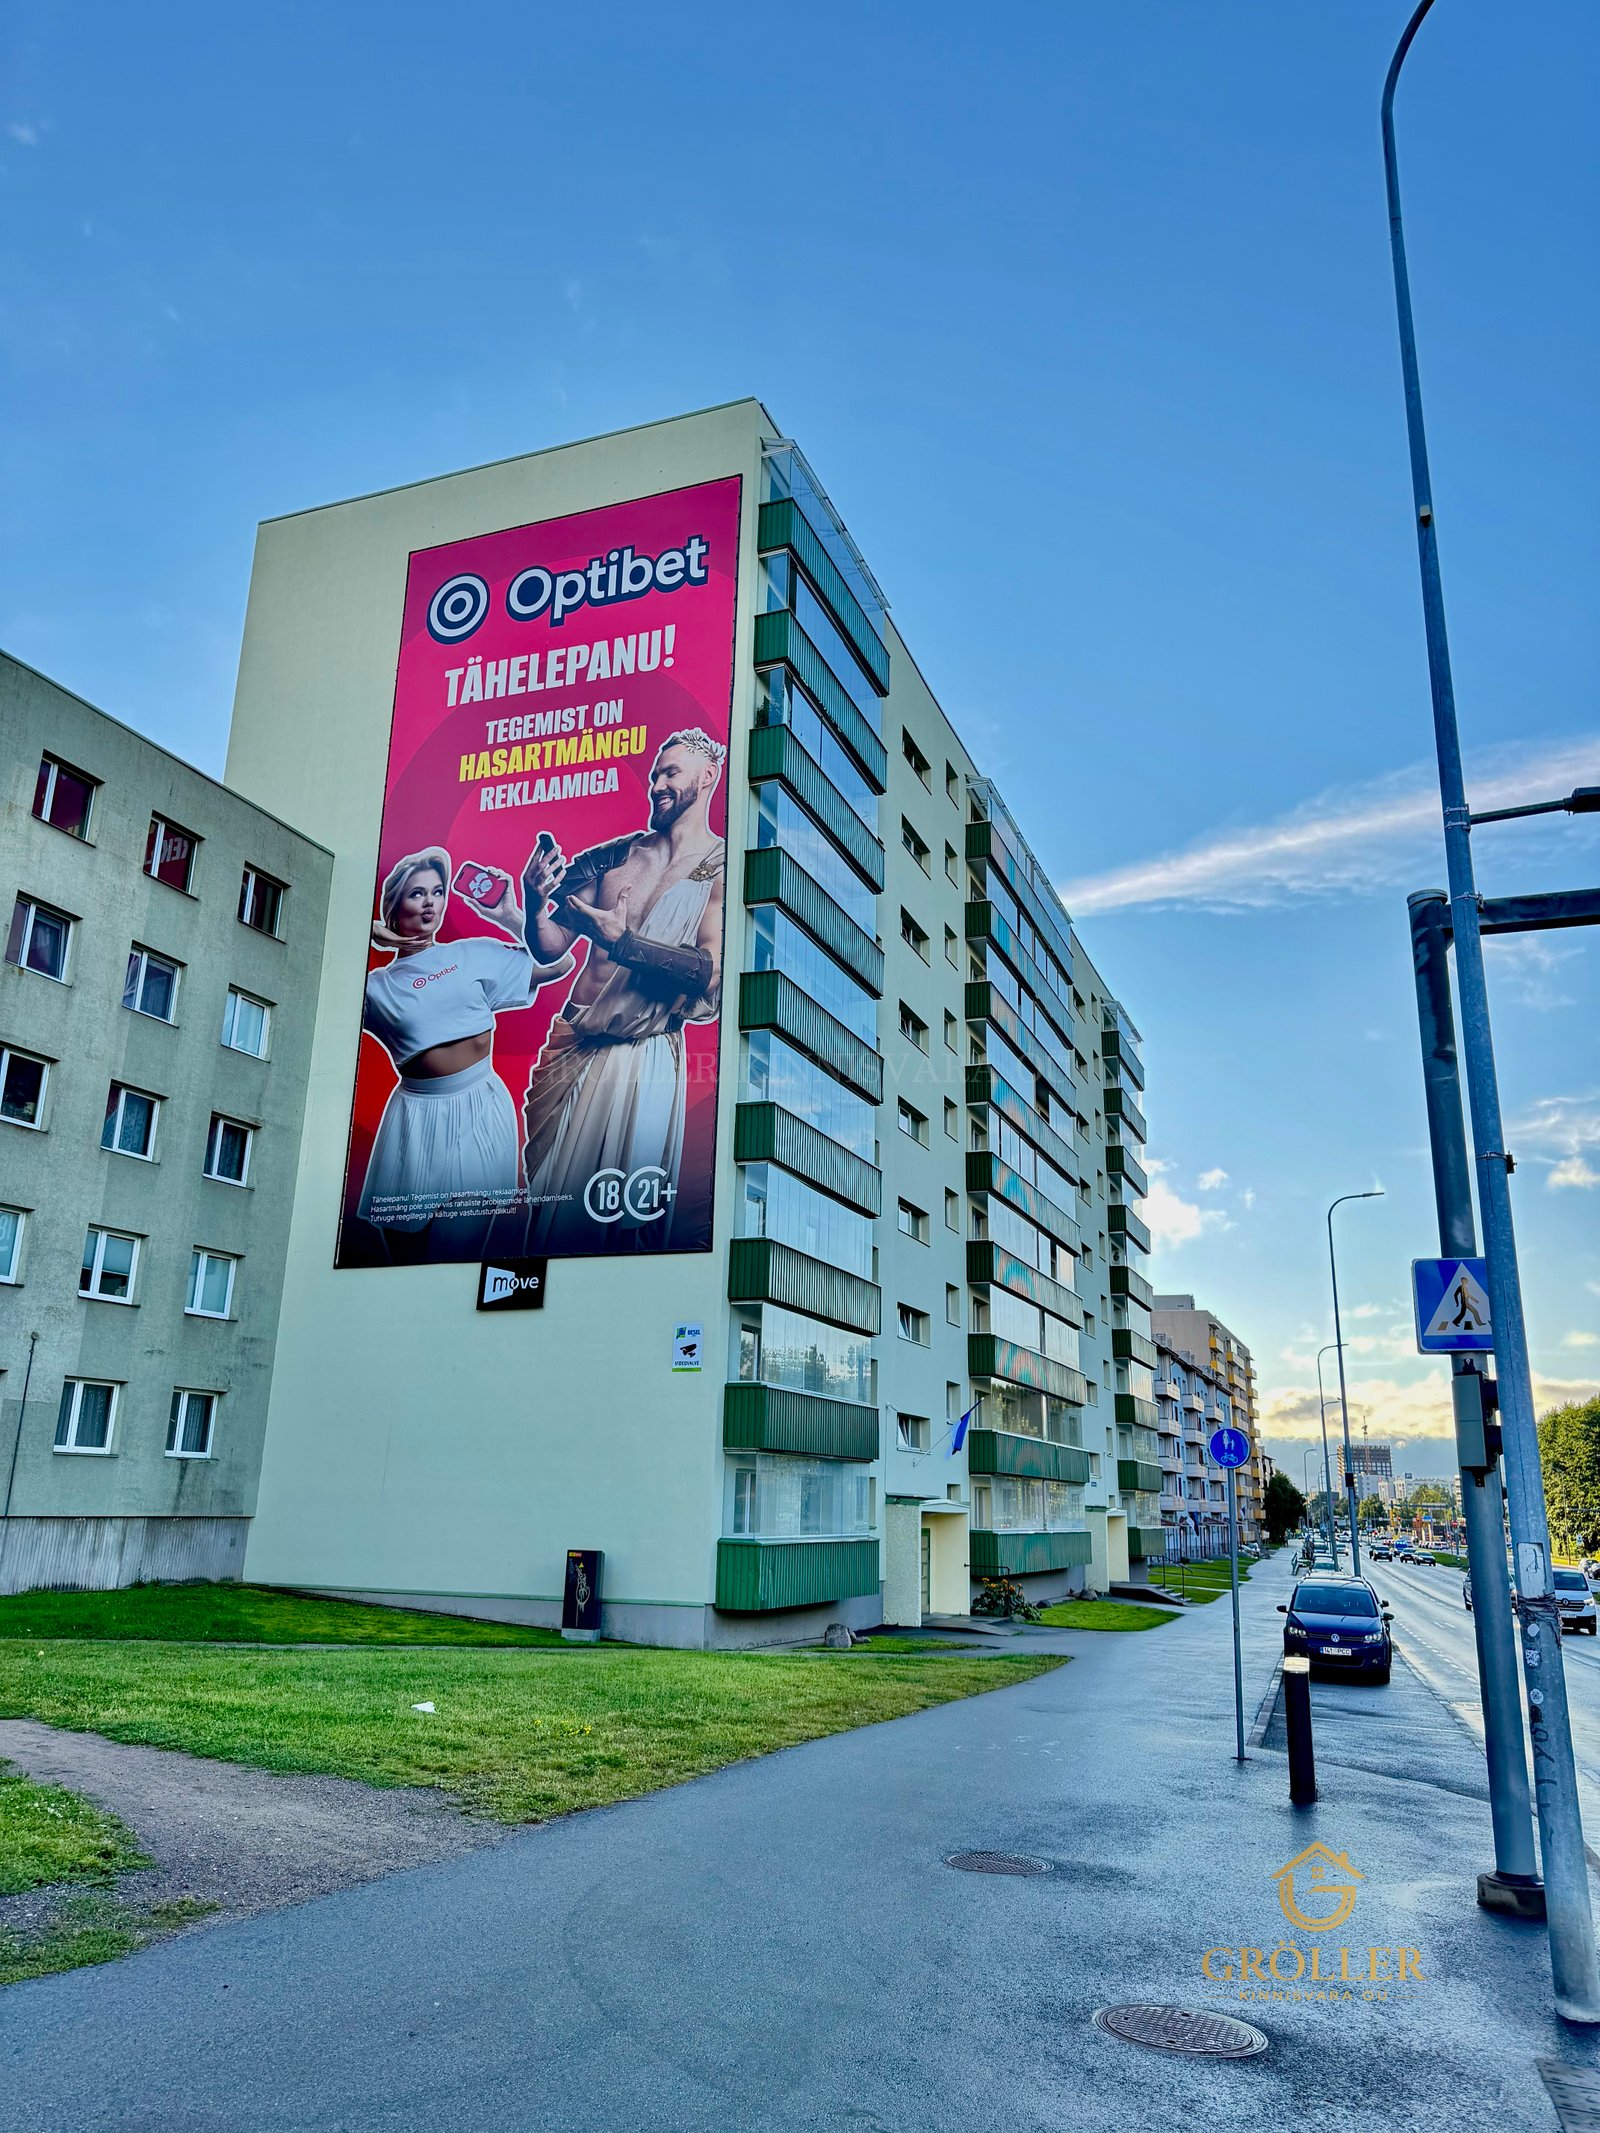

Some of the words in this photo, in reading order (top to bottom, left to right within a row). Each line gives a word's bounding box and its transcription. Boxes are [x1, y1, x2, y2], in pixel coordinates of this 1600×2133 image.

[507, 536, 708, 622] Optibet
[445, 624, 676, 707] TÄHELEPANU!
[486, 705, 589, 744] TEGEMIST
[593, 698, 624, 726] ON
[458, 725, 647, 782] HASARTMÄNGU
[479, 767, 619, 811] REKLAAMIGA
[428, 964, 459, 981] Optibet
[408, 1203, 423, 1212] pole
[411, 1192, 439, 1202] Tegemist
[597, 1180, 620, 1211] 18
[492, 1276, 540, 1293] move
